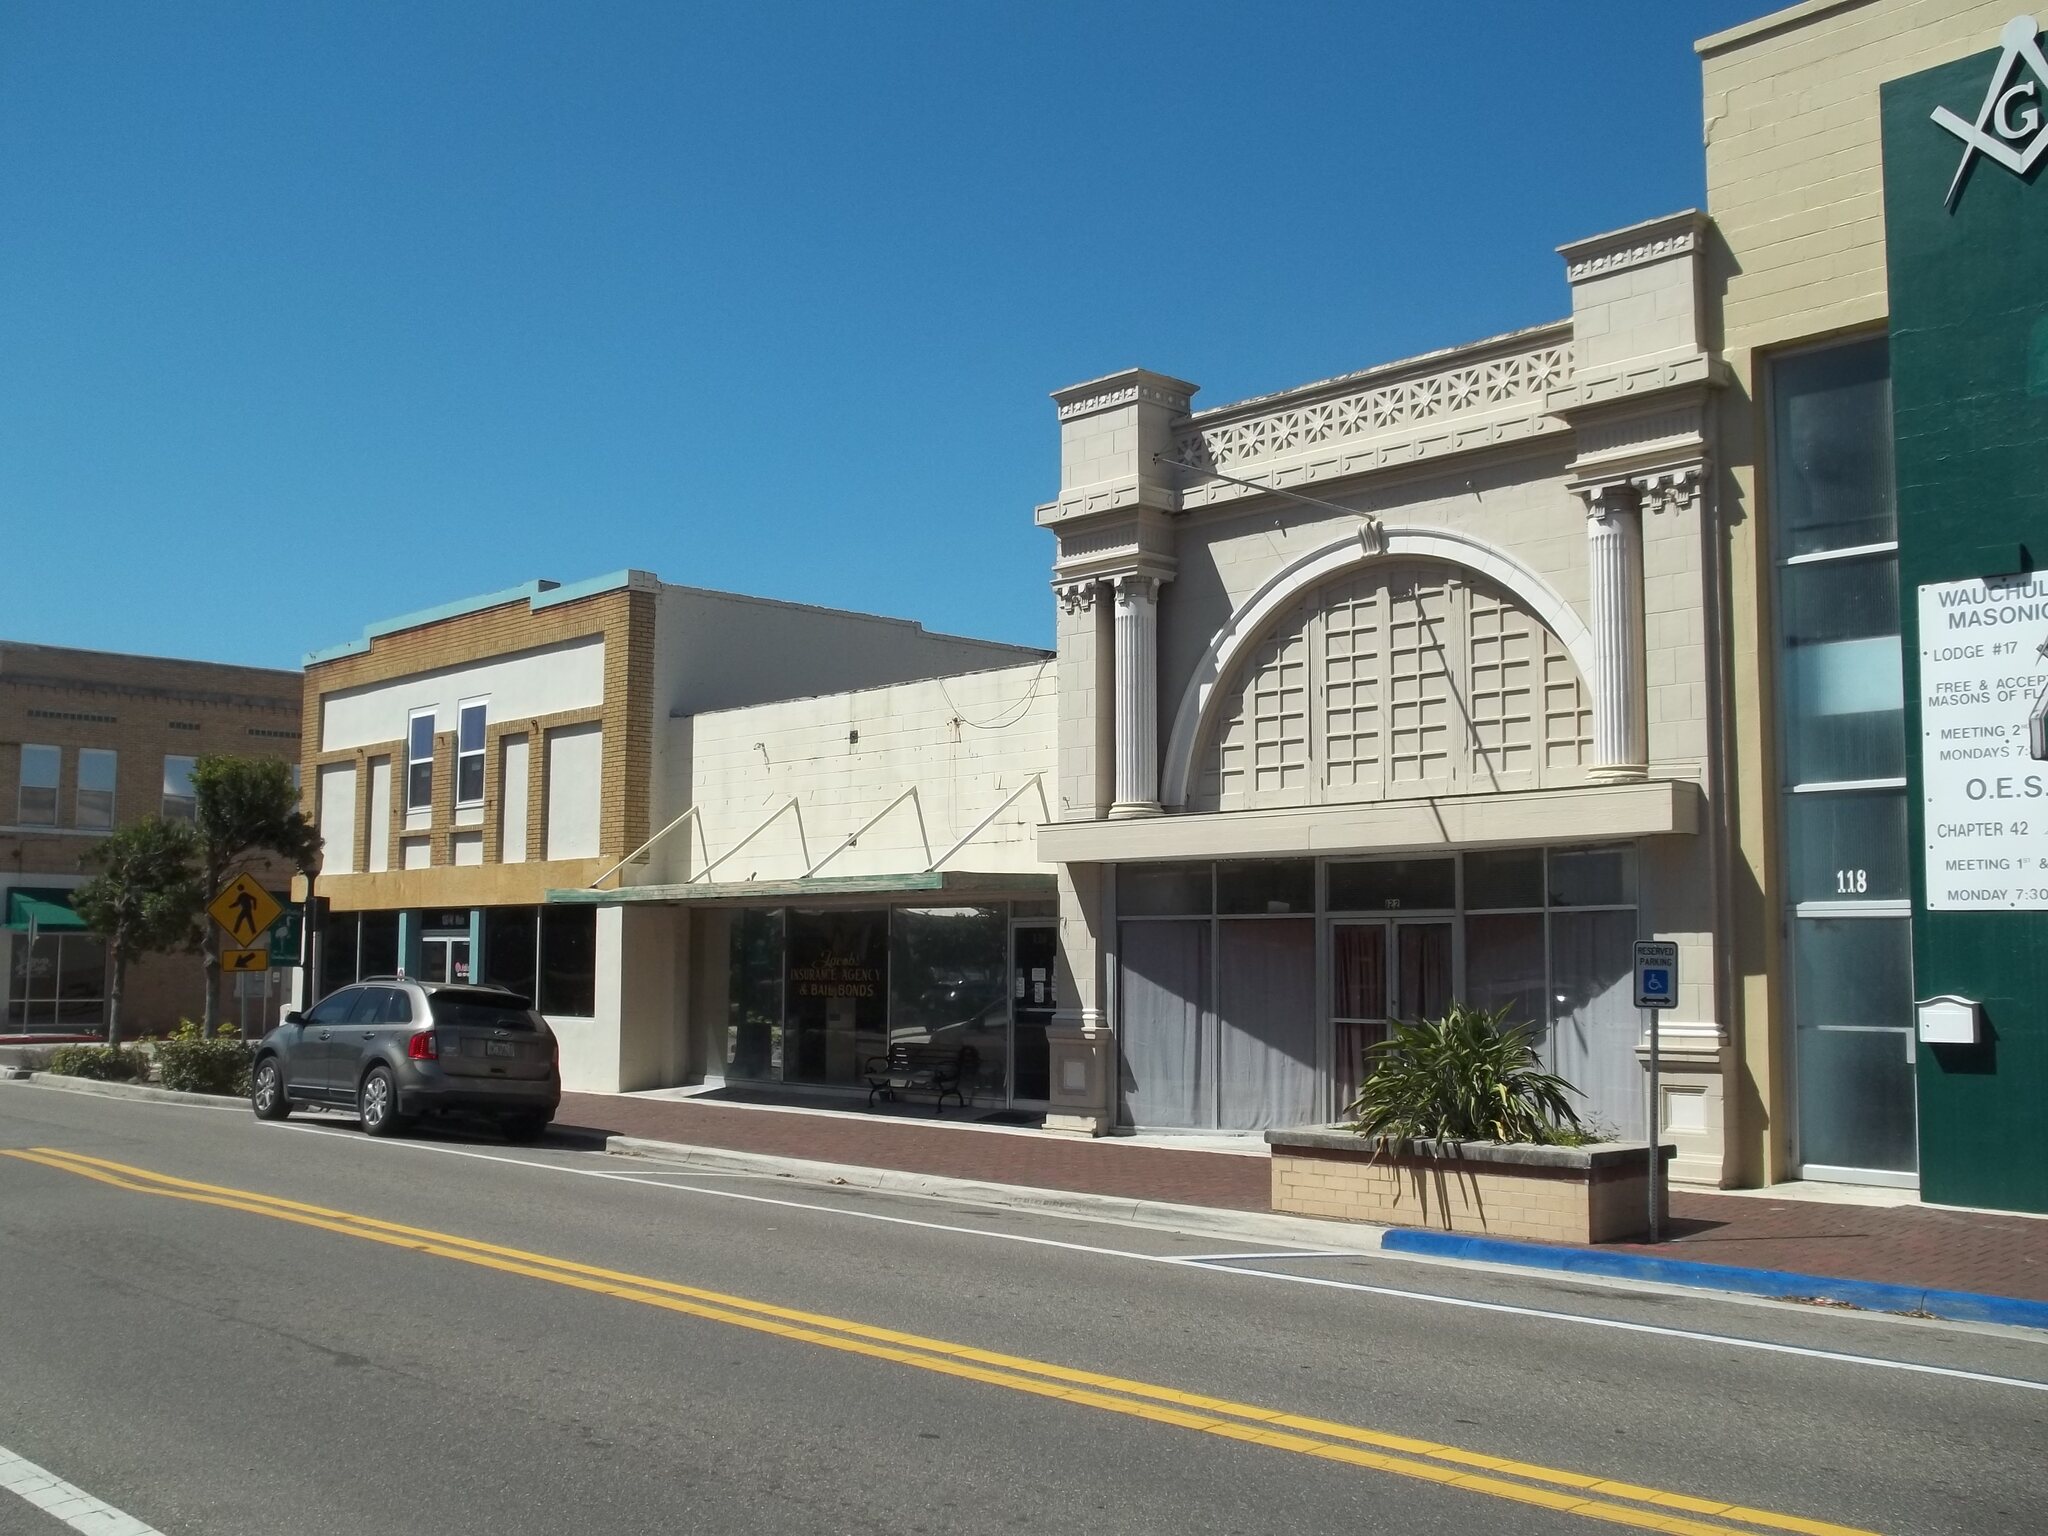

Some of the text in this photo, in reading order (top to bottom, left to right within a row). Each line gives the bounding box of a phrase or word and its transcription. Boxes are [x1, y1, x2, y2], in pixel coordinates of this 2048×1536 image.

[1994, 81, 2038, 139] G
[1934, 641, 2018, 662] LODGE #17
[1936, 674, 2048, 693] FREE & ACCEP
[1928, 691, 1991, 707] MASONS
[1997, 689, 2017, 702] OF
[1941, 725, 2005, 740] MEETING
[1940, 746, 2010, 761] MONDAYS
[1937, 821, 2029, 838] CHAPTER 42
[1946, 858, 2010, 871] MEETING
[2039, 857, 2048, 869] &
[1837, 869, 1867, 894] 118
[1947, 888, 2048, 901] MONDAY 7:30
[1637, 947, 1674, 956] RESERVED
[1640, 957, 1672, 966] PARKING
[842, 968, 880, 981] AGENCY
[810, 983, 834, 996] BAIL
[838, 983, 874, 997] BONDS
